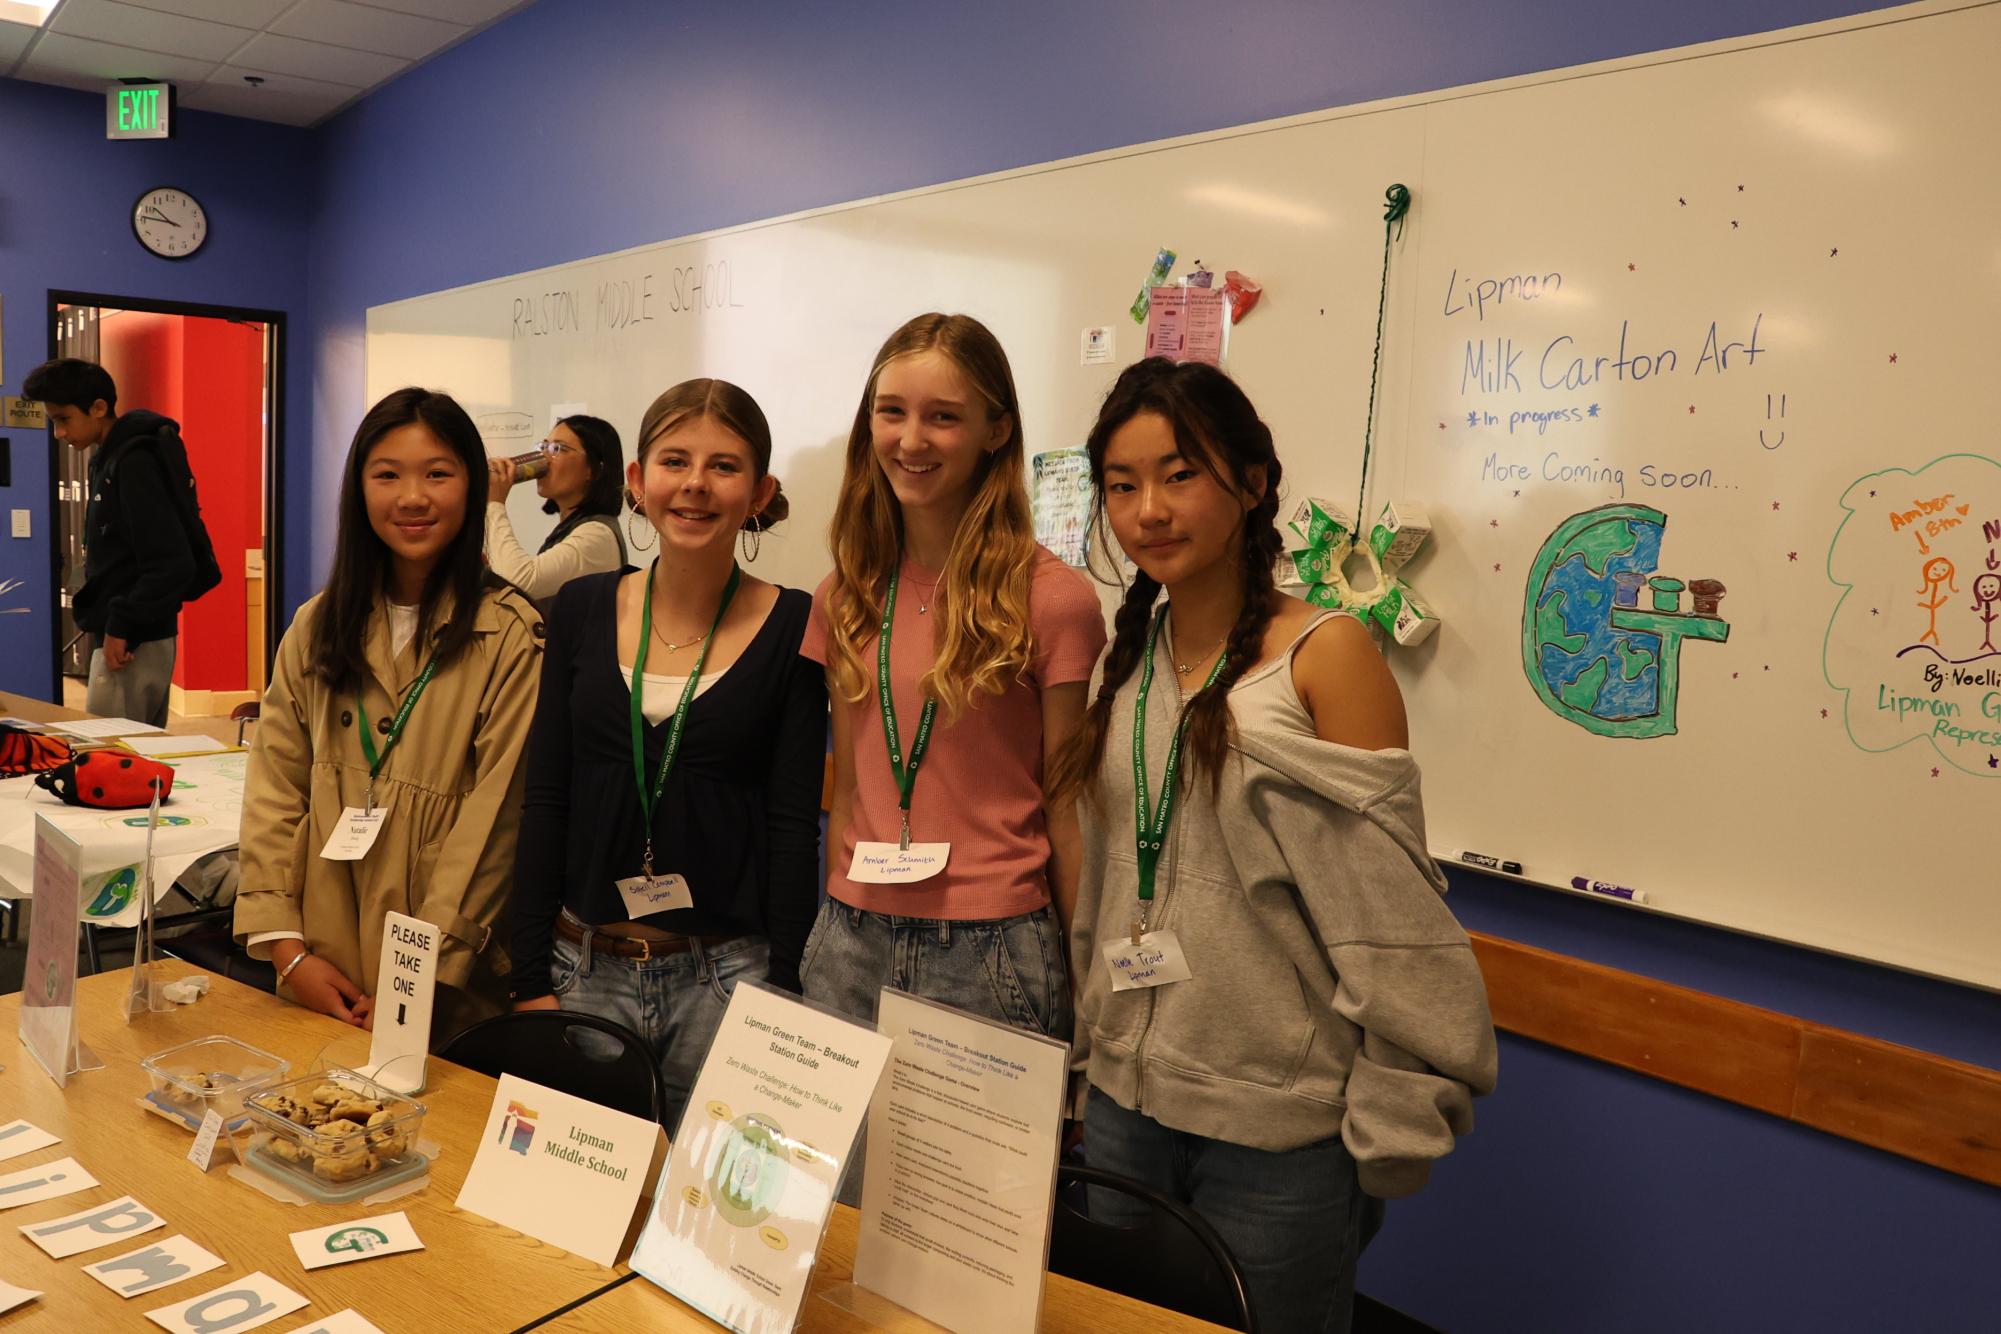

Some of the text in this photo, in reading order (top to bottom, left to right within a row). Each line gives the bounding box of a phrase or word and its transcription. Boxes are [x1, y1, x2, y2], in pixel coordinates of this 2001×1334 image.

[118, 90, 160, 131] EXIT
[512, 259, 744, 340] RALSTON MIDDLE SCHOOL
[1444, 269, 1562, 320] Lipman
[1461, 313, 1766, 396] Milk Carton Art
[9, 409, 41, 419] ROUTE
[1482, 452, 1531, 482] More
[1542, 452, 1624, 499] Coming
[1888, 494, 1955, 532] Amber
[421, 662, 435, 682] COUNTY
[1923, 663, 1949, 693] By:
[393, 704, 409, 731] EDUCATION
[885, 707, 891, 715] OF
[1879, 683, 1961, 723] Lipman
[663, 755, 672, 773] MATEO
[668, 731, 679, 754] COUNTY
[674, 713, 683, 731] OFFICE
[679, 703, 684, 712] OF
[682, 676, 696, 705] EDUCATION
[887, 716, 896, 748] EDUCATION
[915, 701, 934, 755] SAN MATEO COUNTY
[1138, 787, 1144, 795] OF
[1155, 820, 1164, 834] SAN
[1160, 800, 1168, 820] MATEO
[1164, 770, 1172, 799] COUNTY
[1168, 747, 1177, 770] OFFICE
[1138, 795, 1146, 832] EDUCATION
[862, 855, 889, 865] Amber
[880, 866, 912, 874] Lipman
[391, 924, 431, 951] PLEASE
[394, 950, 421, 973] TAKE
[1136, 950, 1164, 967] Trout
[393, 976, 415, 997] ONE
[744, 1015, 772, 1033] Lipman
[772, 1026, 795, 1043] Green
[796, 1035, 817, 1052] Team
[823, 1046, 860, 1069] Breakout
[769, 1041, 820, 1070] Station Guide
[908, 1027, 928, 1039] Lipman
[928, 1034, 944, 1044] Green
[944, 1039, 959, 1050] Team
[963, 1046, 989, 1059] Breakout
[989, 1054, 1012, 1067] Station
[1010, 1062, 1027, 1073] Guide
[726, 1056, 842, 1113] Zero Waste Challenge: How to Think Like
[759, 1084, 803, 1110] Change-Maker
[569, 1126, 615, 1153] Lipman
[544, 1141, 628, 1181] Middle School
